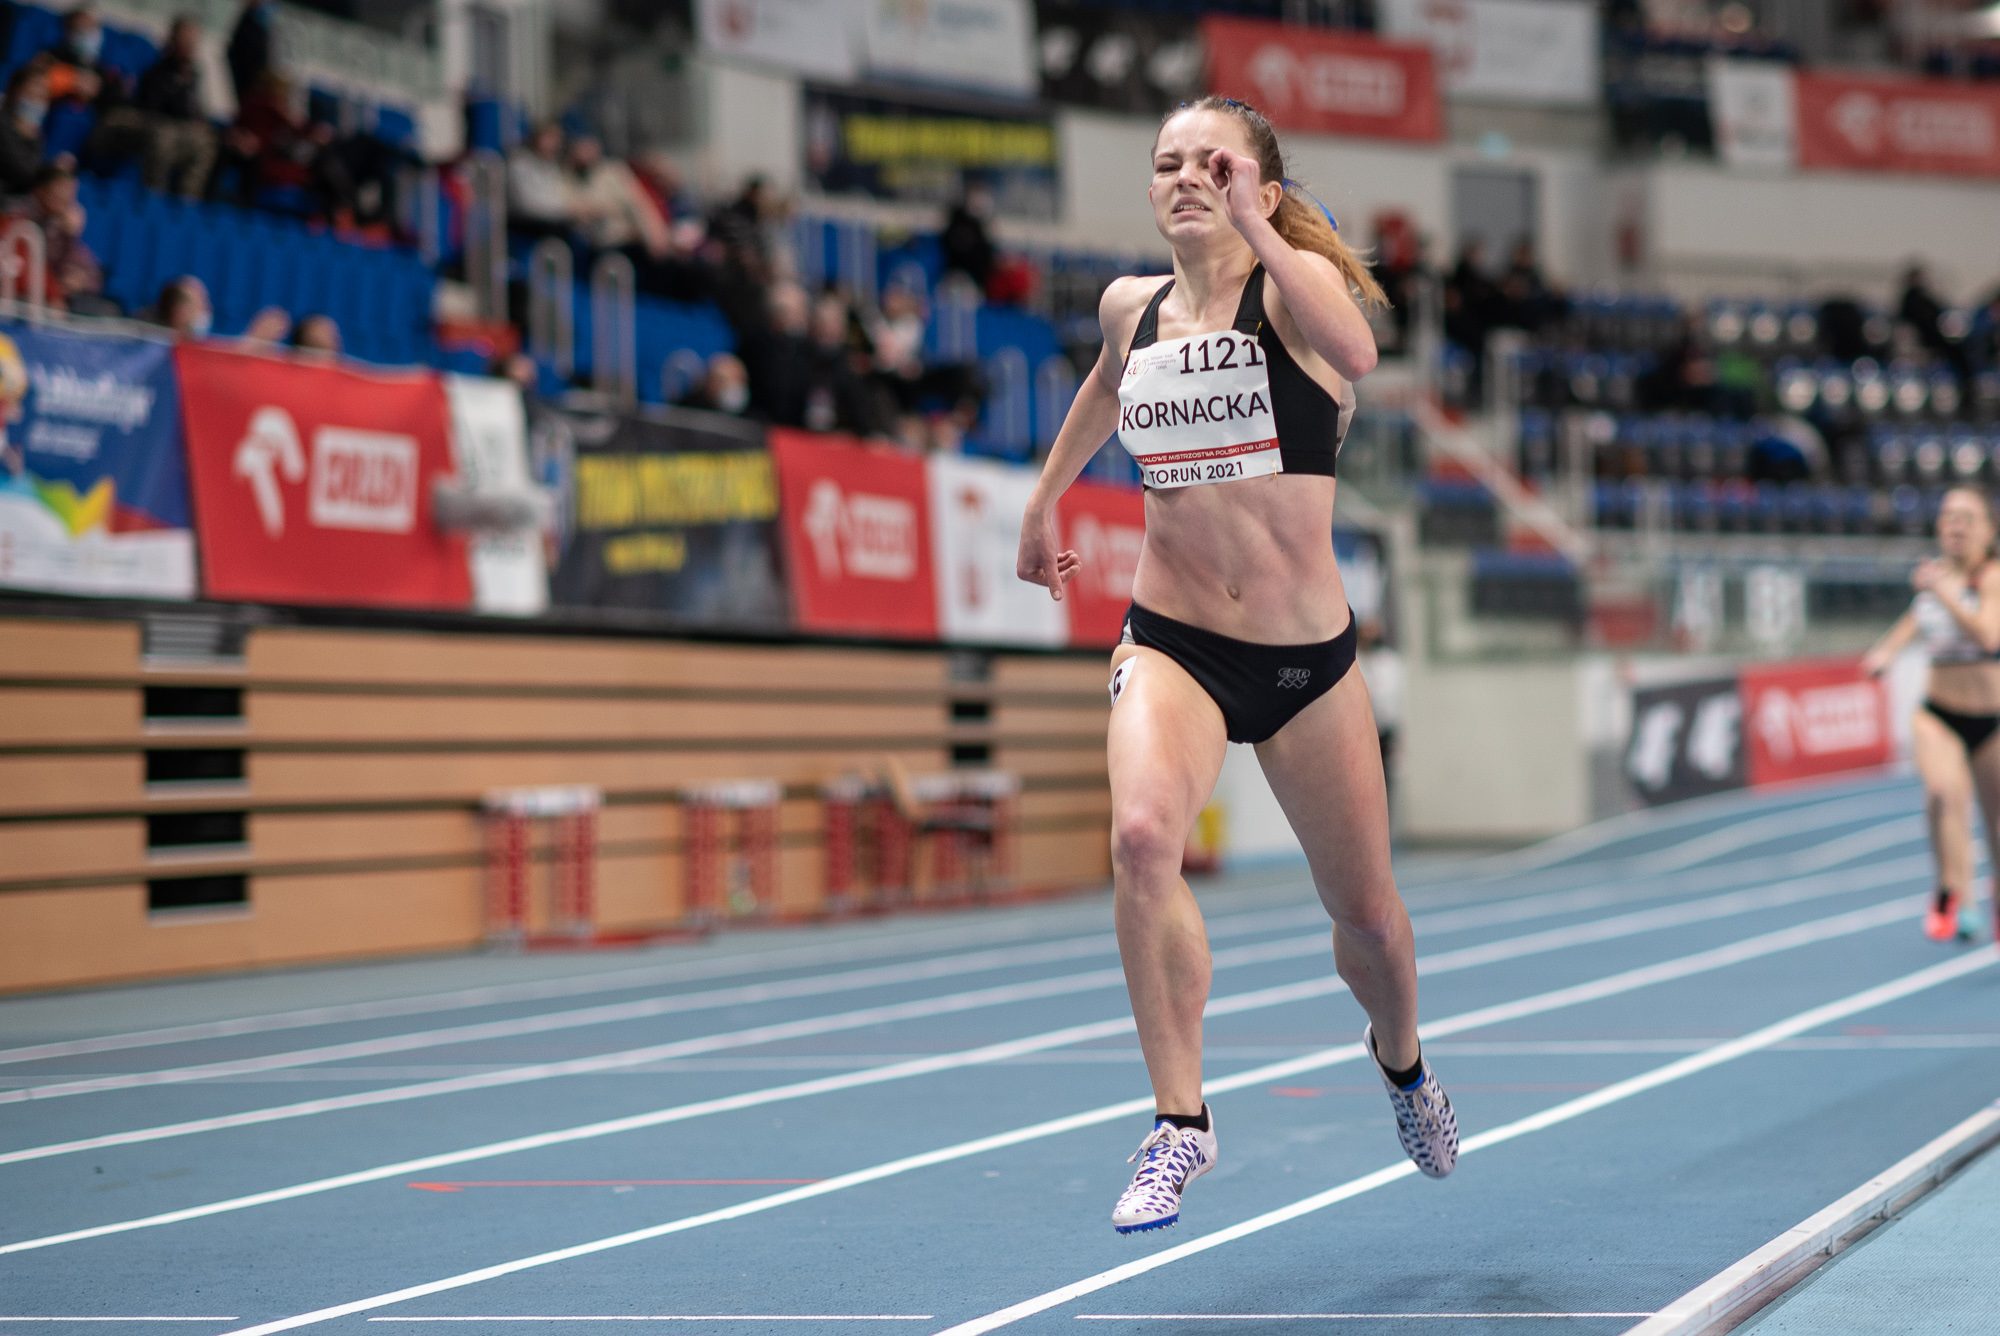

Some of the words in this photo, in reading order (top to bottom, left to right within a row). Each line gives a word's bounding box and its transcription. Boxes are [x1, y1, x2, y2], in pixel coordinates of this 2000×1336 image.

[1179, 337, 1263, 374] 1121
[1121, 391, 1269, 431] KORNACKA
[1168, 451, 1215, 461] MISTRZOSTWA
[1215, 447, 1239, 456] POLSKI
[1255, 442, 1271, 450] U20
[1149, 462, 1202, 485] TORUŃ
[1206, 461, 1243, 479] 2021
